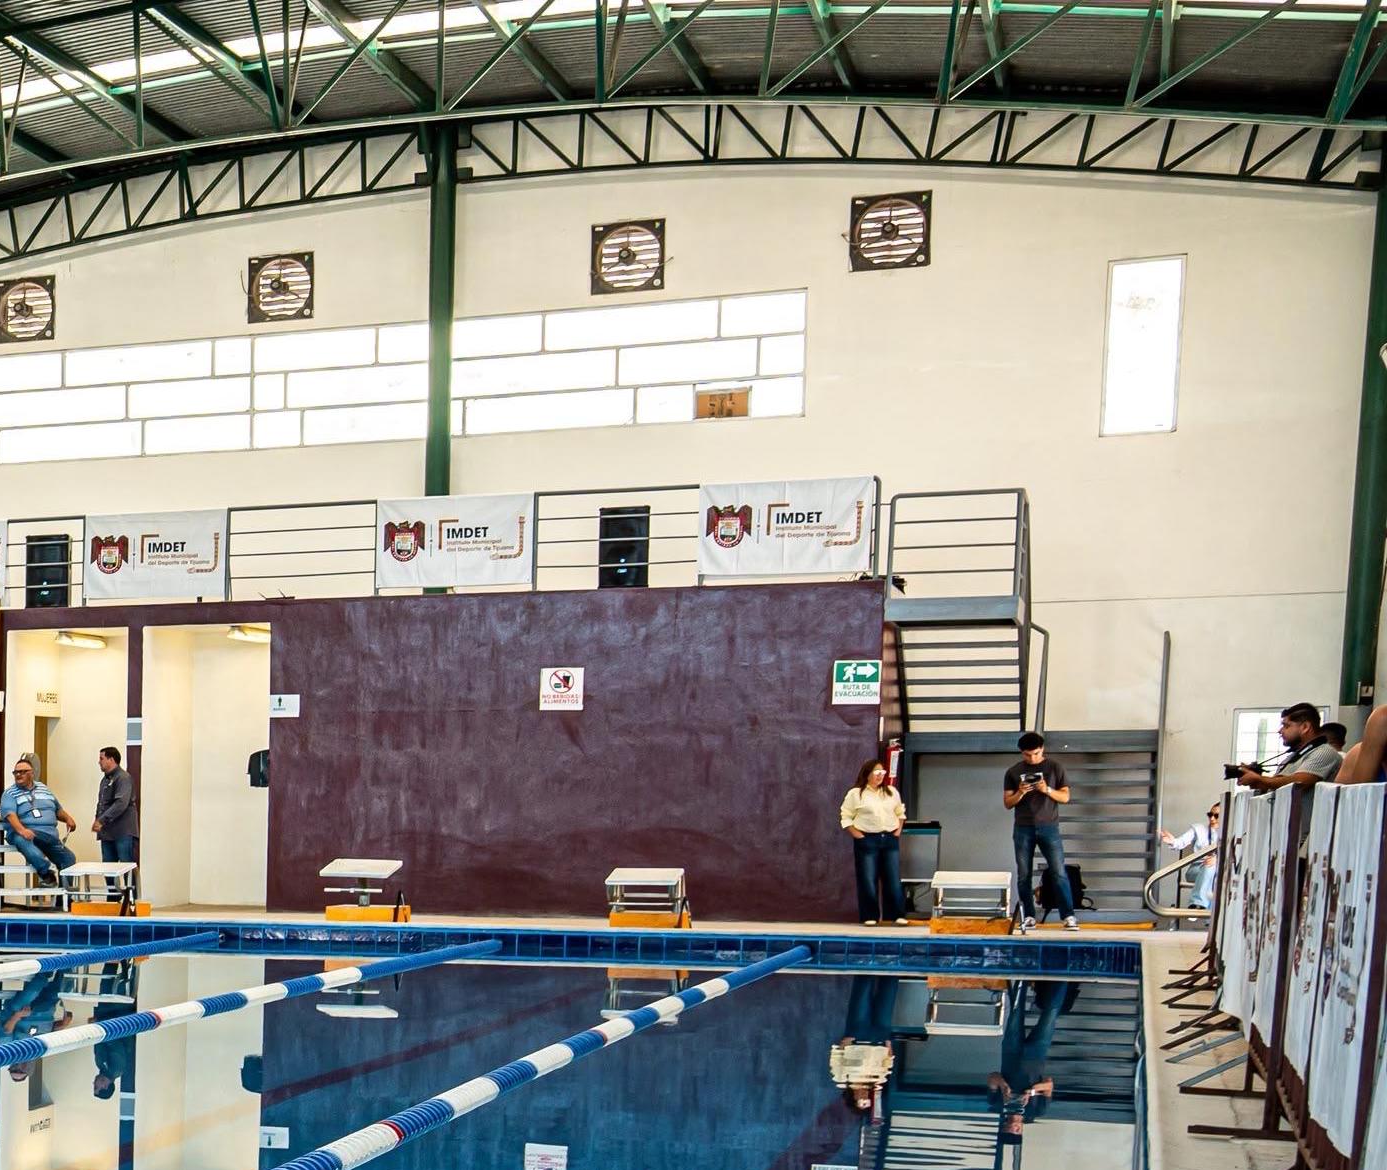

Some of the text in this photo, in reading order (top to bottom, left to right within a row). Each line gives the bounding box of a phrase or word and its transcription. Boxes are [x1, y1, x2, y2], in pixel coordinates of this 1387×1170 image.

[777, 512, 822, 523] IMDET
[447, 527, 488, 538] IMDET
[148, 542, 186, 553] IMDET
